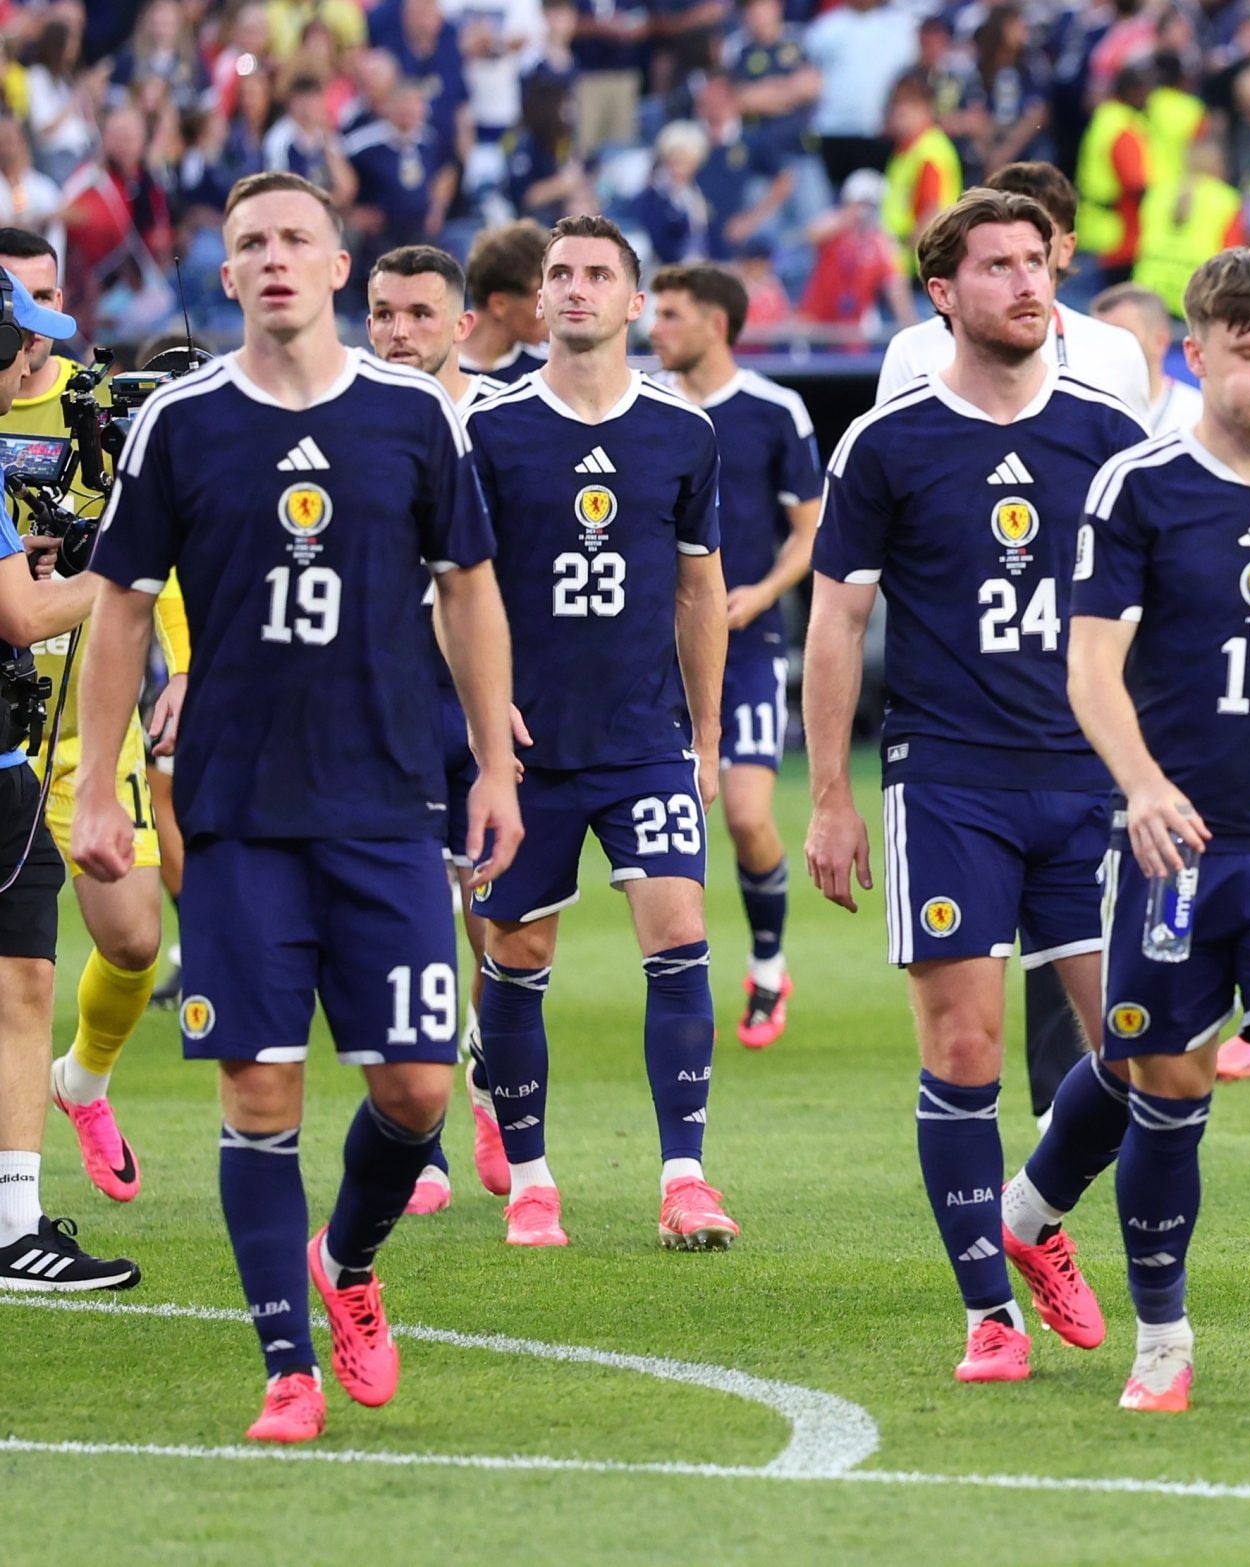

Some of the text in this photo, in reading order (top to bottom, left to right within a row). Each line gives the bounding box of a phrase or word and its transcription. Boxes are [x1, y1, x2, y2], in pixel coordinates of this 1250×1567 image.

[261, 565, 342, 646] 19
[553, 552, 626, 617] 23
[978, 577, 1062, 654] 24
[734, 702, 777, 756] 11
[125, 773, 156, 829] 1
[631, 793, 701, 856] 23
[386, 962, 456, 1045] 19
[494, 1079, 540, 1099] ALBA
[678, 1066, 713, 1082] ALB
[0, 1173, 35, 1184] didas
[946, 1186, 995, 1208] ALBA
[1128, 1214, 1186, 1232] ALBA
